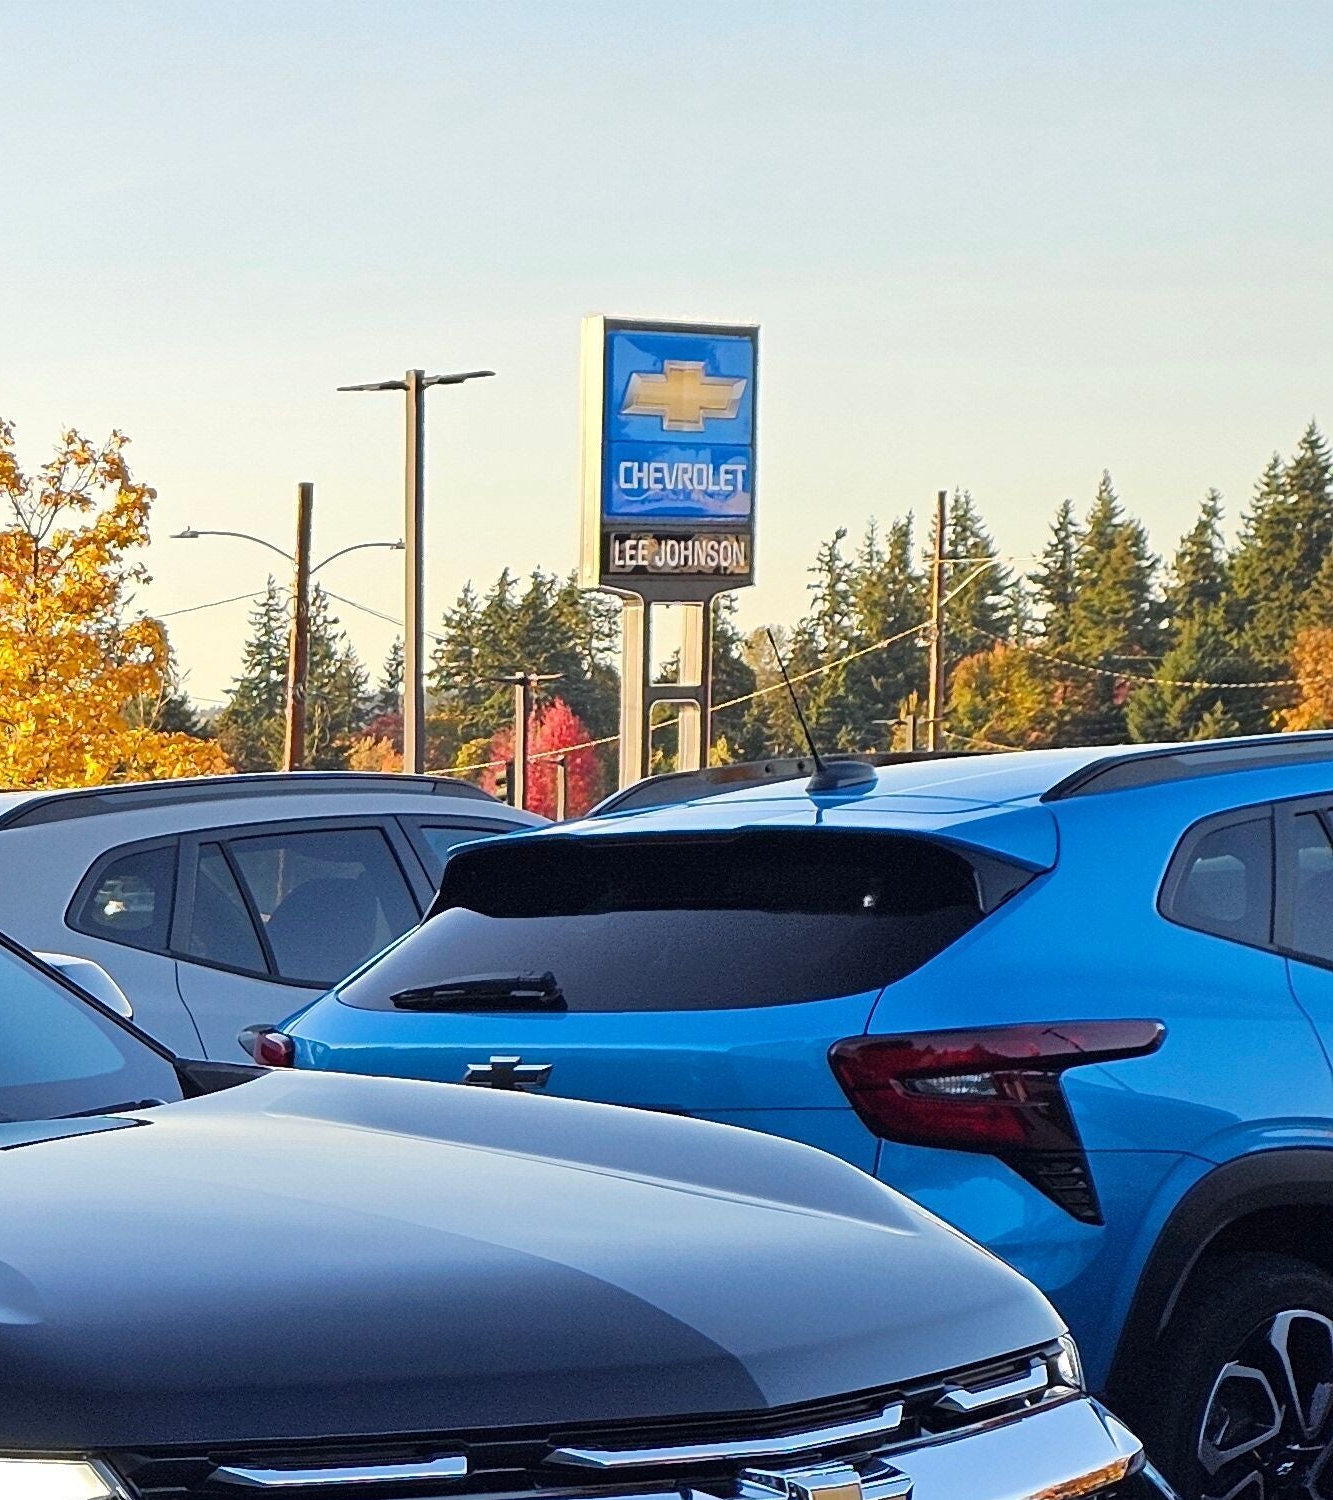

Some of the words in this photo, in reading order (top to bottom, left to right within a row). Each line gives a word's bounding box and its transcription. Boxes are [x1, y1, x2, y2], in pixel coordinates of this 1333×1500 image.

[618, 460, 748, 492] CHEVROLET
[614, 539, 649, 566] LEE
[654, 539, 746, 567] JOHNSON
